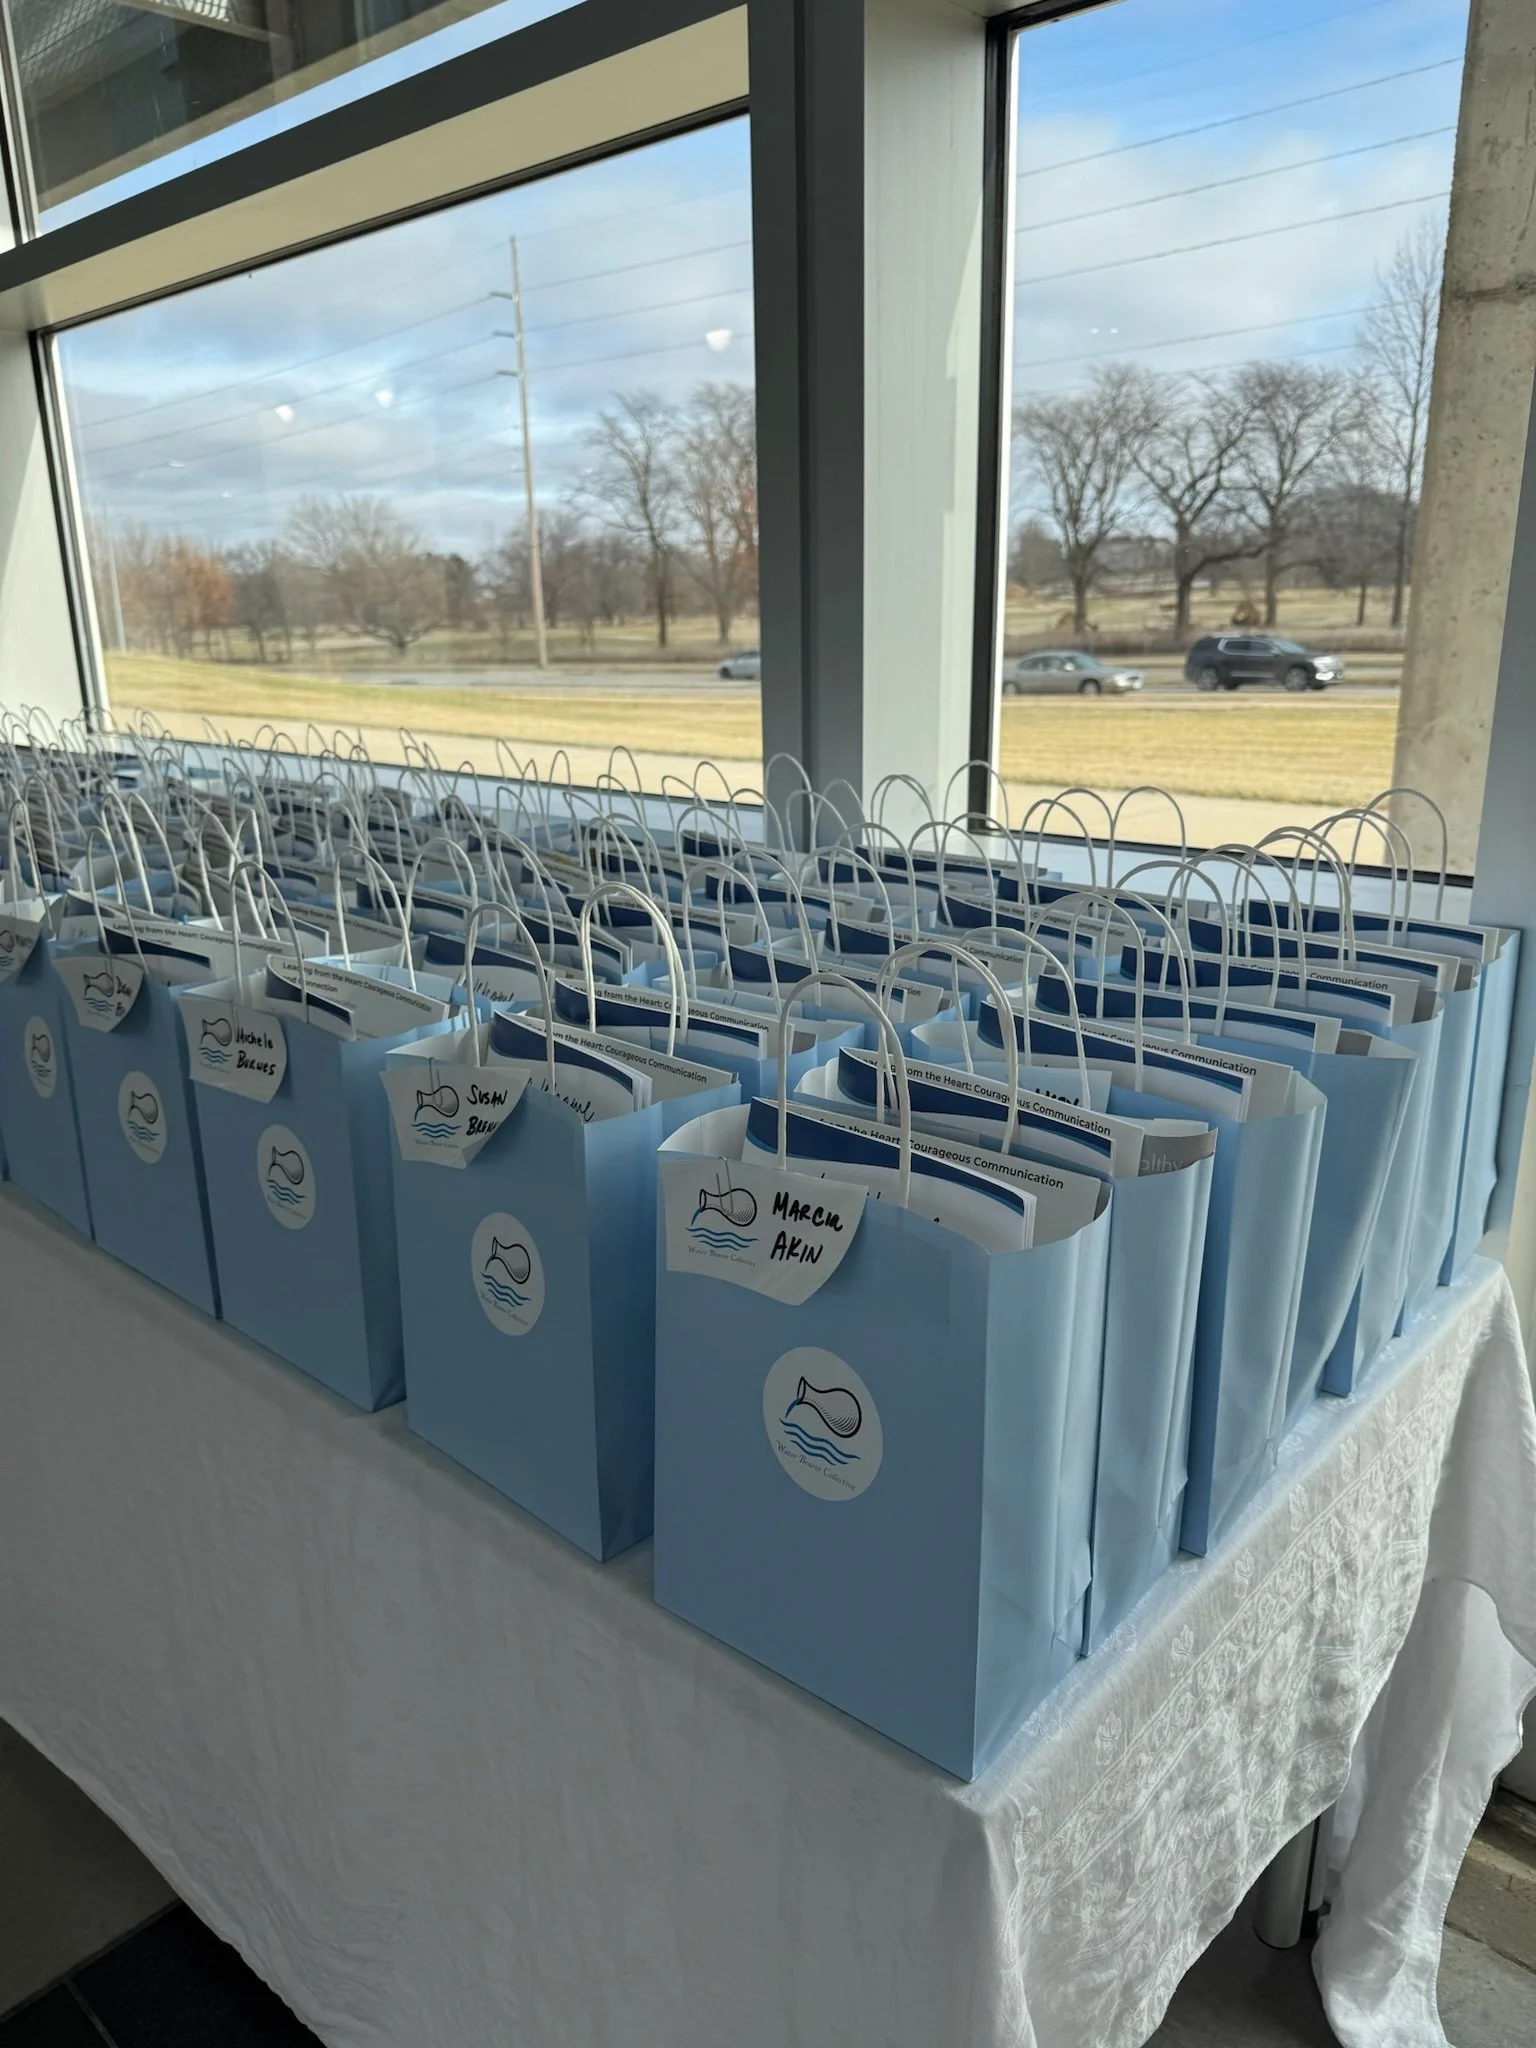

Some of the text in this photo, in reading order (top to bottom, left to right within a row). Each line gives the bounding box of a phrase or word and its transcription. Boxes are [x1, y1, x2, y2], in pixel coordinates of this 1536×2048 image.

[604, 989, 624, 1000] from
[625, 993, 638, 1002] the
[565, 1033, 579, 1045] the
[605, 1044, 647, 1065] Courageous
[648, 1057, 707, 1083] Communication
[925, 1071, 941, 1081] the
[1032, 1101, 1111, 1137] Communication
[973, 1156, 1064, 1189] Communication
[770, 1230, 824, 1265] AKIN
[776, 1439, 799, 1459] Water
[823, 1466, 856, 1491] Collective
